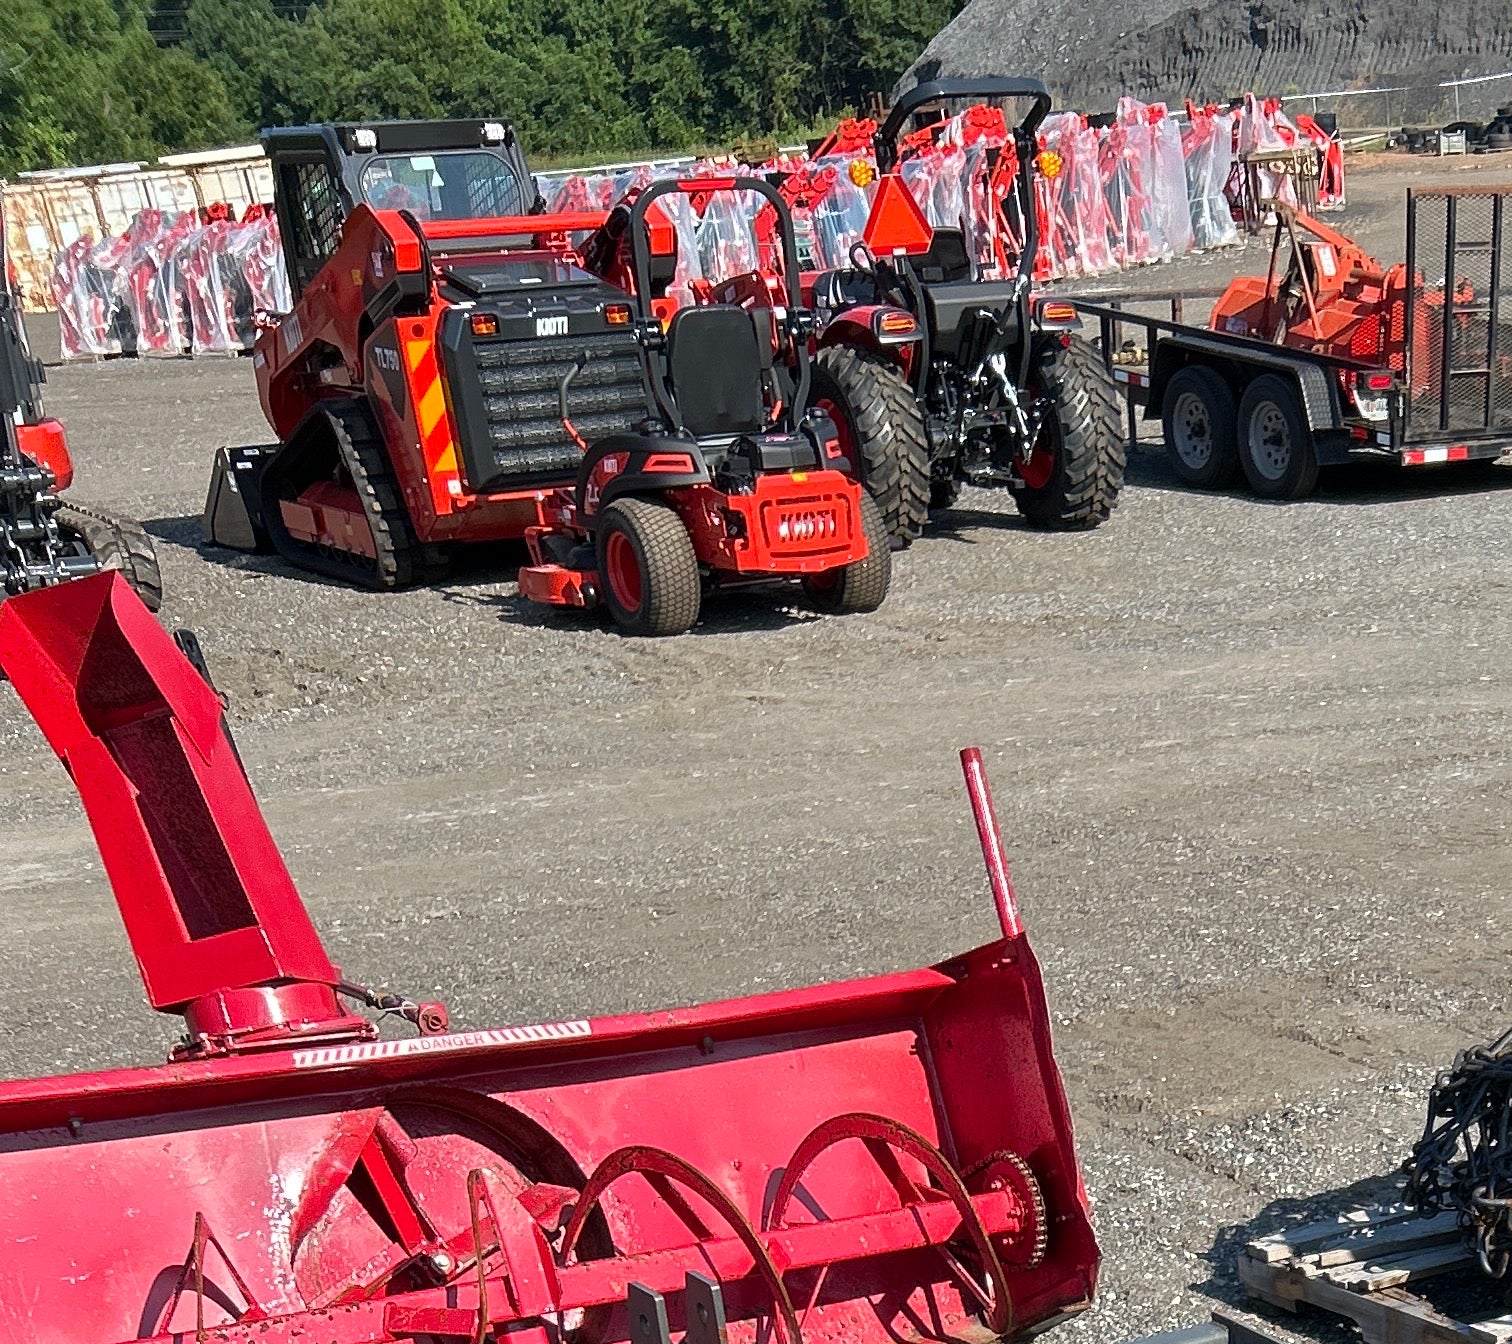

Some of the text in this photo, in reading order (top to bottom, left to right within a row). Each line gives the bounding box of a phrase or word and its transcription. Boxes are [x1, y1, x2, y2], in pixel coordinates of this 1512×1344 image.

[536, 316, 568, 336] KIOTI
[780, 508, 836, 543] KIOTI
[421, 1032, 486, 1051] DANGER
